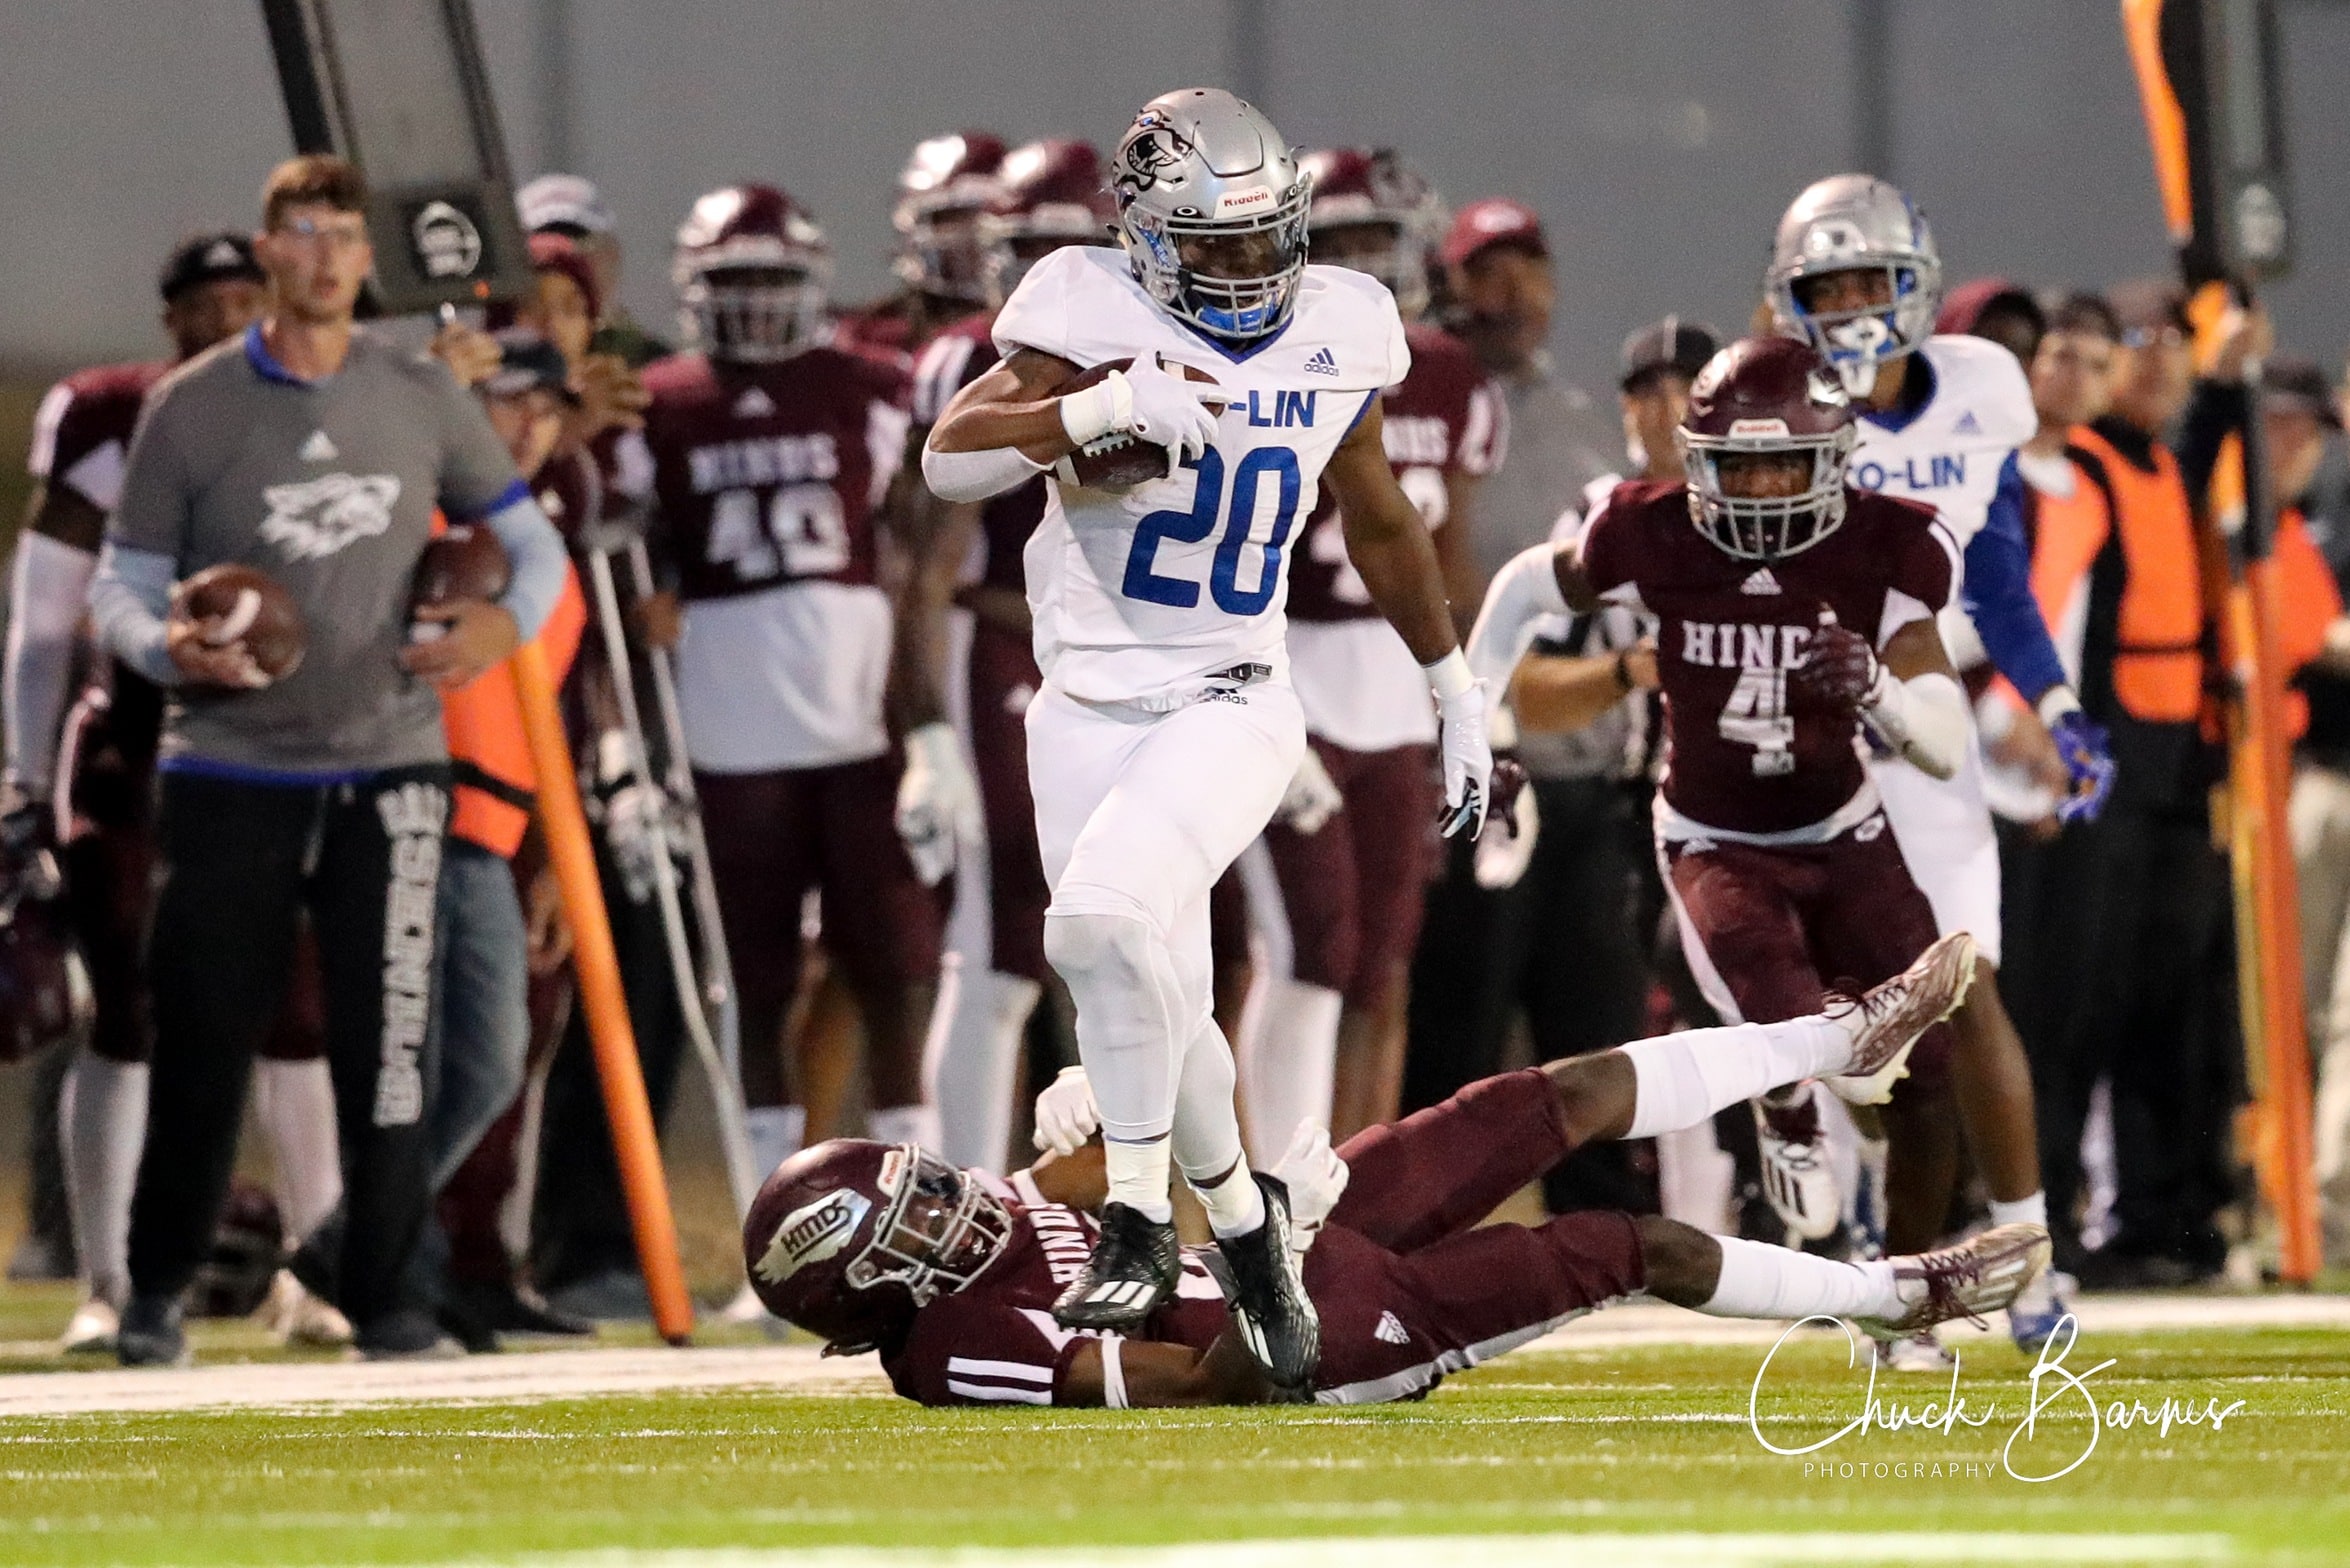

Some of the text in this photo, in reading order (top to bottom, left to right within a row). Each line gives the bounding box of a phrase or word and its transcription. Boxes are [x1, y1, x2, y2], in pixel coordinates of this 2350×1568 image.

[1303, 363, 1340, 377] adidas
[1228, 389, 1317, 427] -LIN
[1852, 453, 1966, 491] O-LIN
[1122, 443, 1302, 616] 20
[1681, 620, 1813, 670] HIND
[1717, 667, 1795, 777] 4
[1028, 1203, 1091, 1284] HIND
